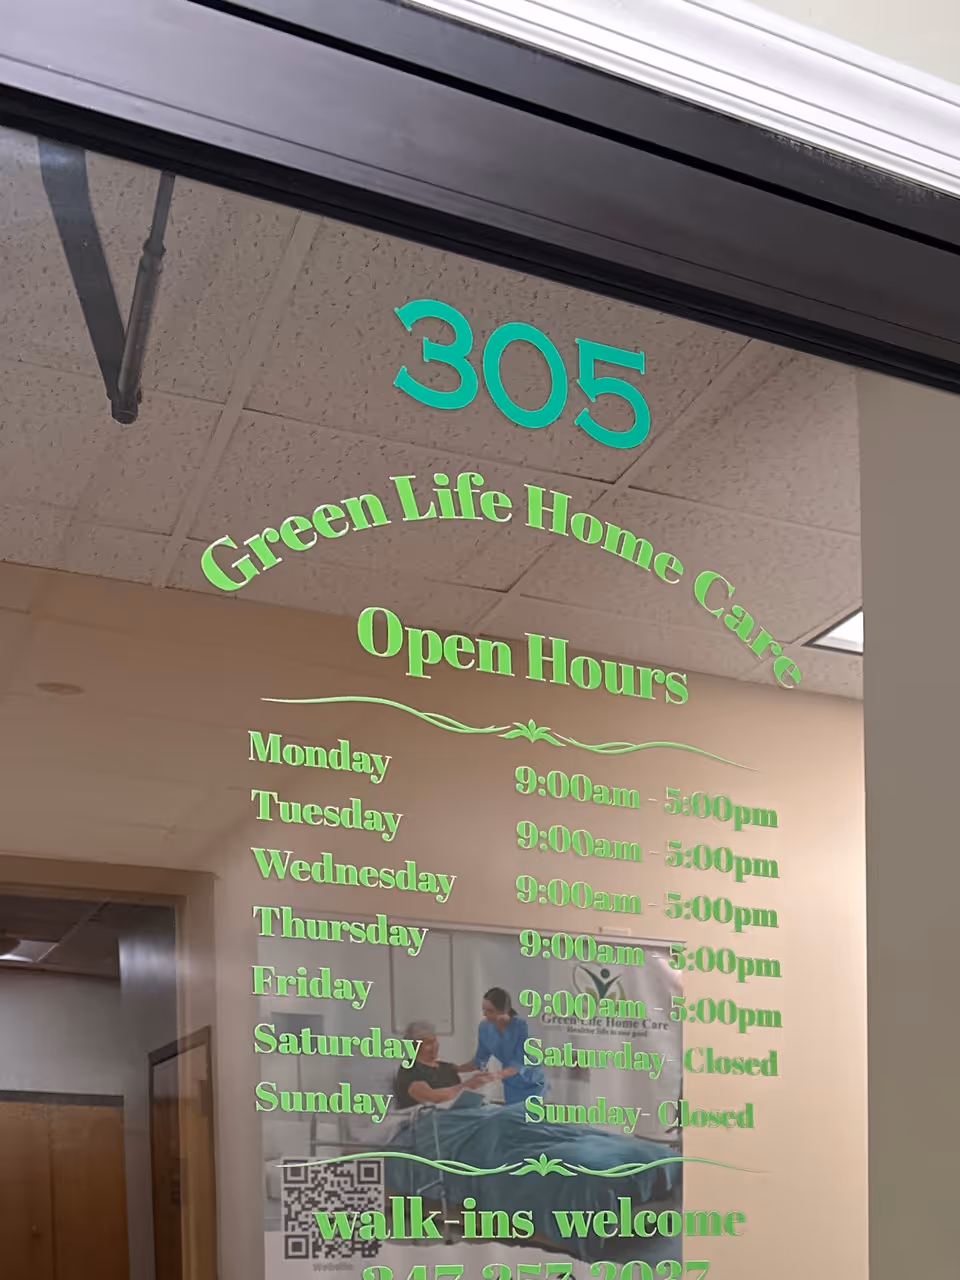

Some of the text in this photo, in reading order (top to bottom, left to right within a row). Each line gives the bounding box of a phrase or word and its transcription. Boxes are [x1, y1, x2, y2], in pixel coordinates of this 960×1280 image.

[393, 298, 652, 449] 305
[200, 471, 803, 690] Green Life Home Care
[356, 605, 690, 706] Open Hours
[248, 730, 392, 784] Monday
[251, 789, 404, 842] Tuesday
[514, 766, 642, 809] 9:00am
[664, 786, 779, 831] 5:00pm
[250, 846, 458, 904] Wednesday
[516, 820, 643, 863] 9:00am
[665, 840, 780, 883] 5:00pm
[515, 874, 643, 915] 9:00am
[664, 891, 780, 933] 5:00pm
[252, 905, 430, 957] Thursday
[519, 929, 646, 967] 9:00am
[668, 943, 783, 983] 5:00pm
[251, 965, 374, 1010] Friday
[519, 989, 648, 1020] 9:00am
[669, 995, 784, 1035] 5:00pm
[253, 1023, 424, 1069] Saturday
[541, 1012, 578, 1026] Green
[605, 1017, 640, 1030] Home
[642, 1018, 670, 1031] Care
[684, 1046, 779, 1077] Closed
[255, 1081, 394, 1124] Sunday
[657, 1098, 755, 1130] Closed
[312, 1195, 747, 1240] walk-ins welcome
